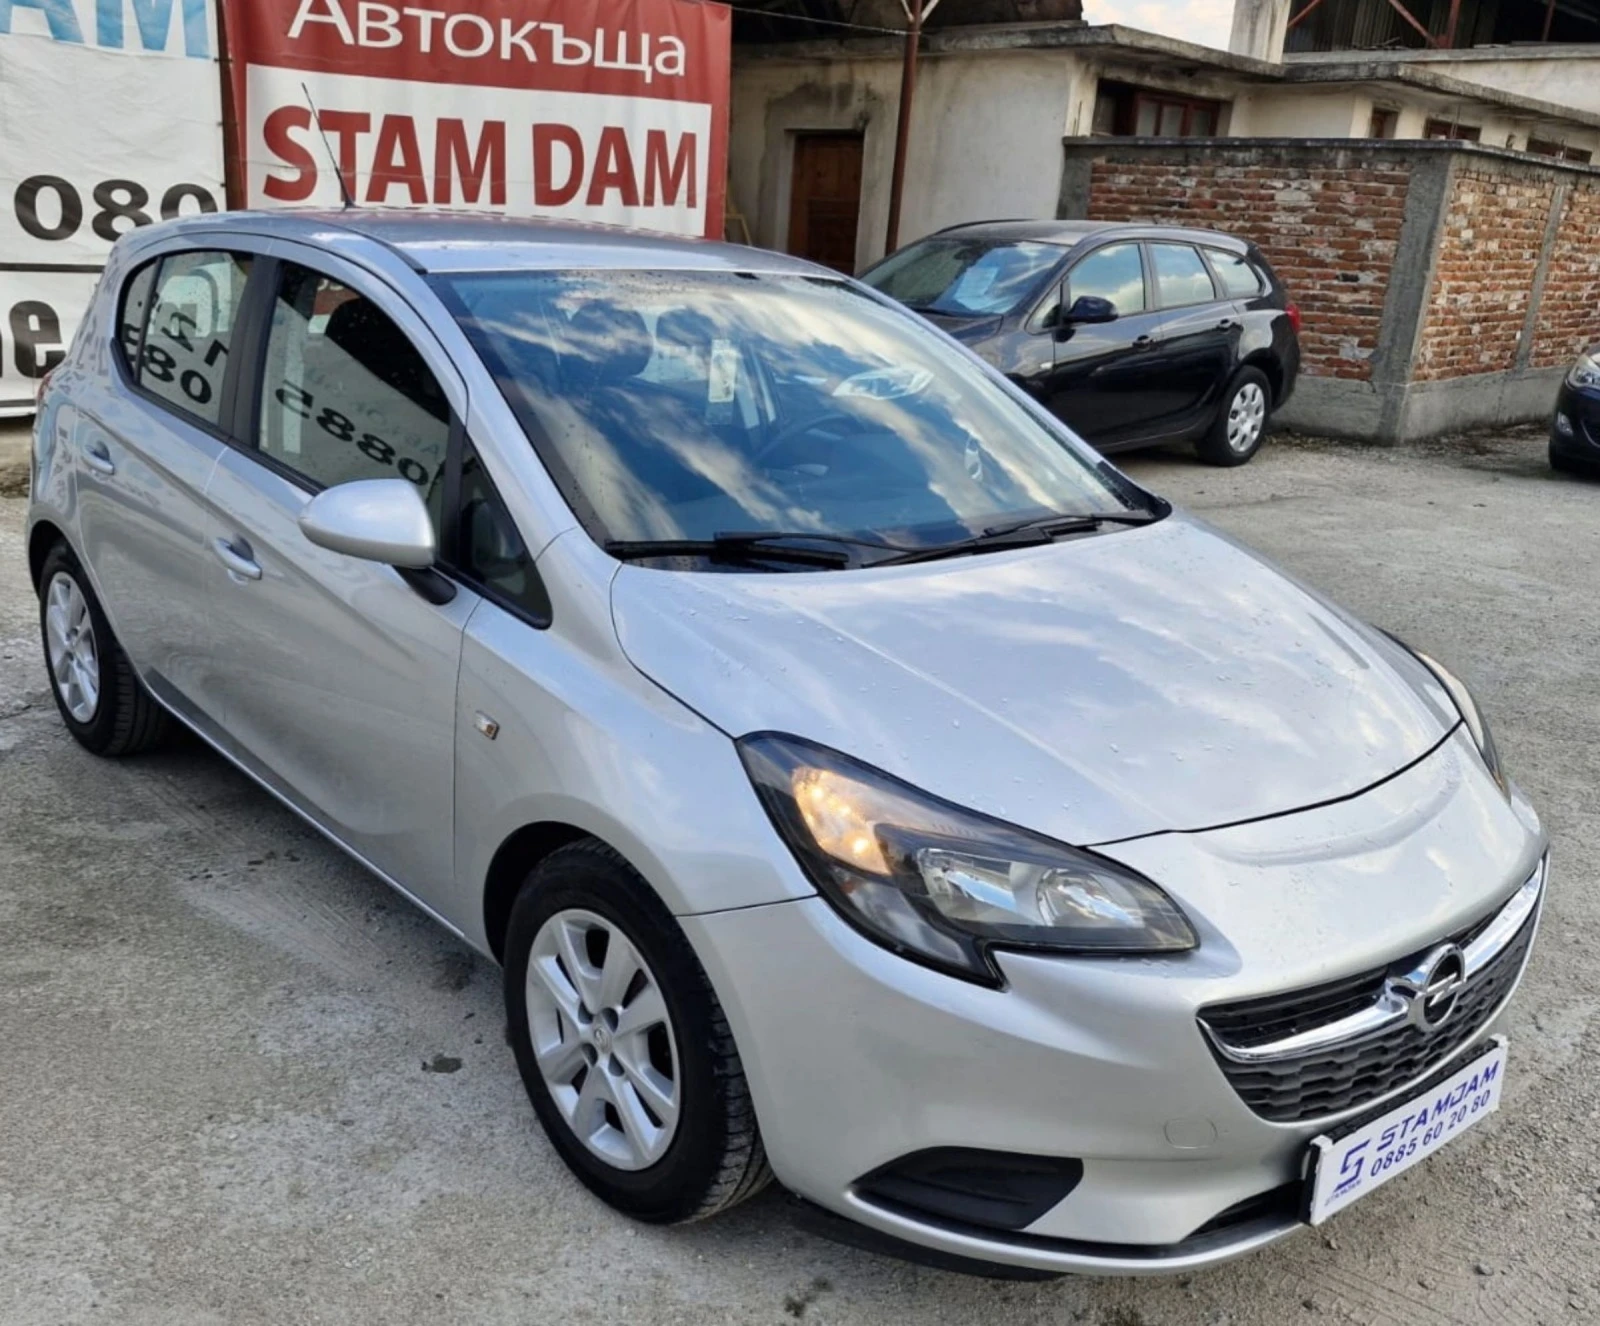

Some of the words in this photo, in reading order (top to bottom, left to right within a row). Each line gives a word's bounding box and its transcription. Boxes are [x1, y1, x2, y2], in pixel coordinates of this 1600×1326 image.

[263, 105, 506, 205] STAM
[532, 123, 698, 209] DAM
[1370, 1137, 1418, 1177] 0885
[1422, 1121, 1444, 1146] 60
[1448, 1104, 1467, 1130] 20
[1471, 1089, 1491, 1114] 80
